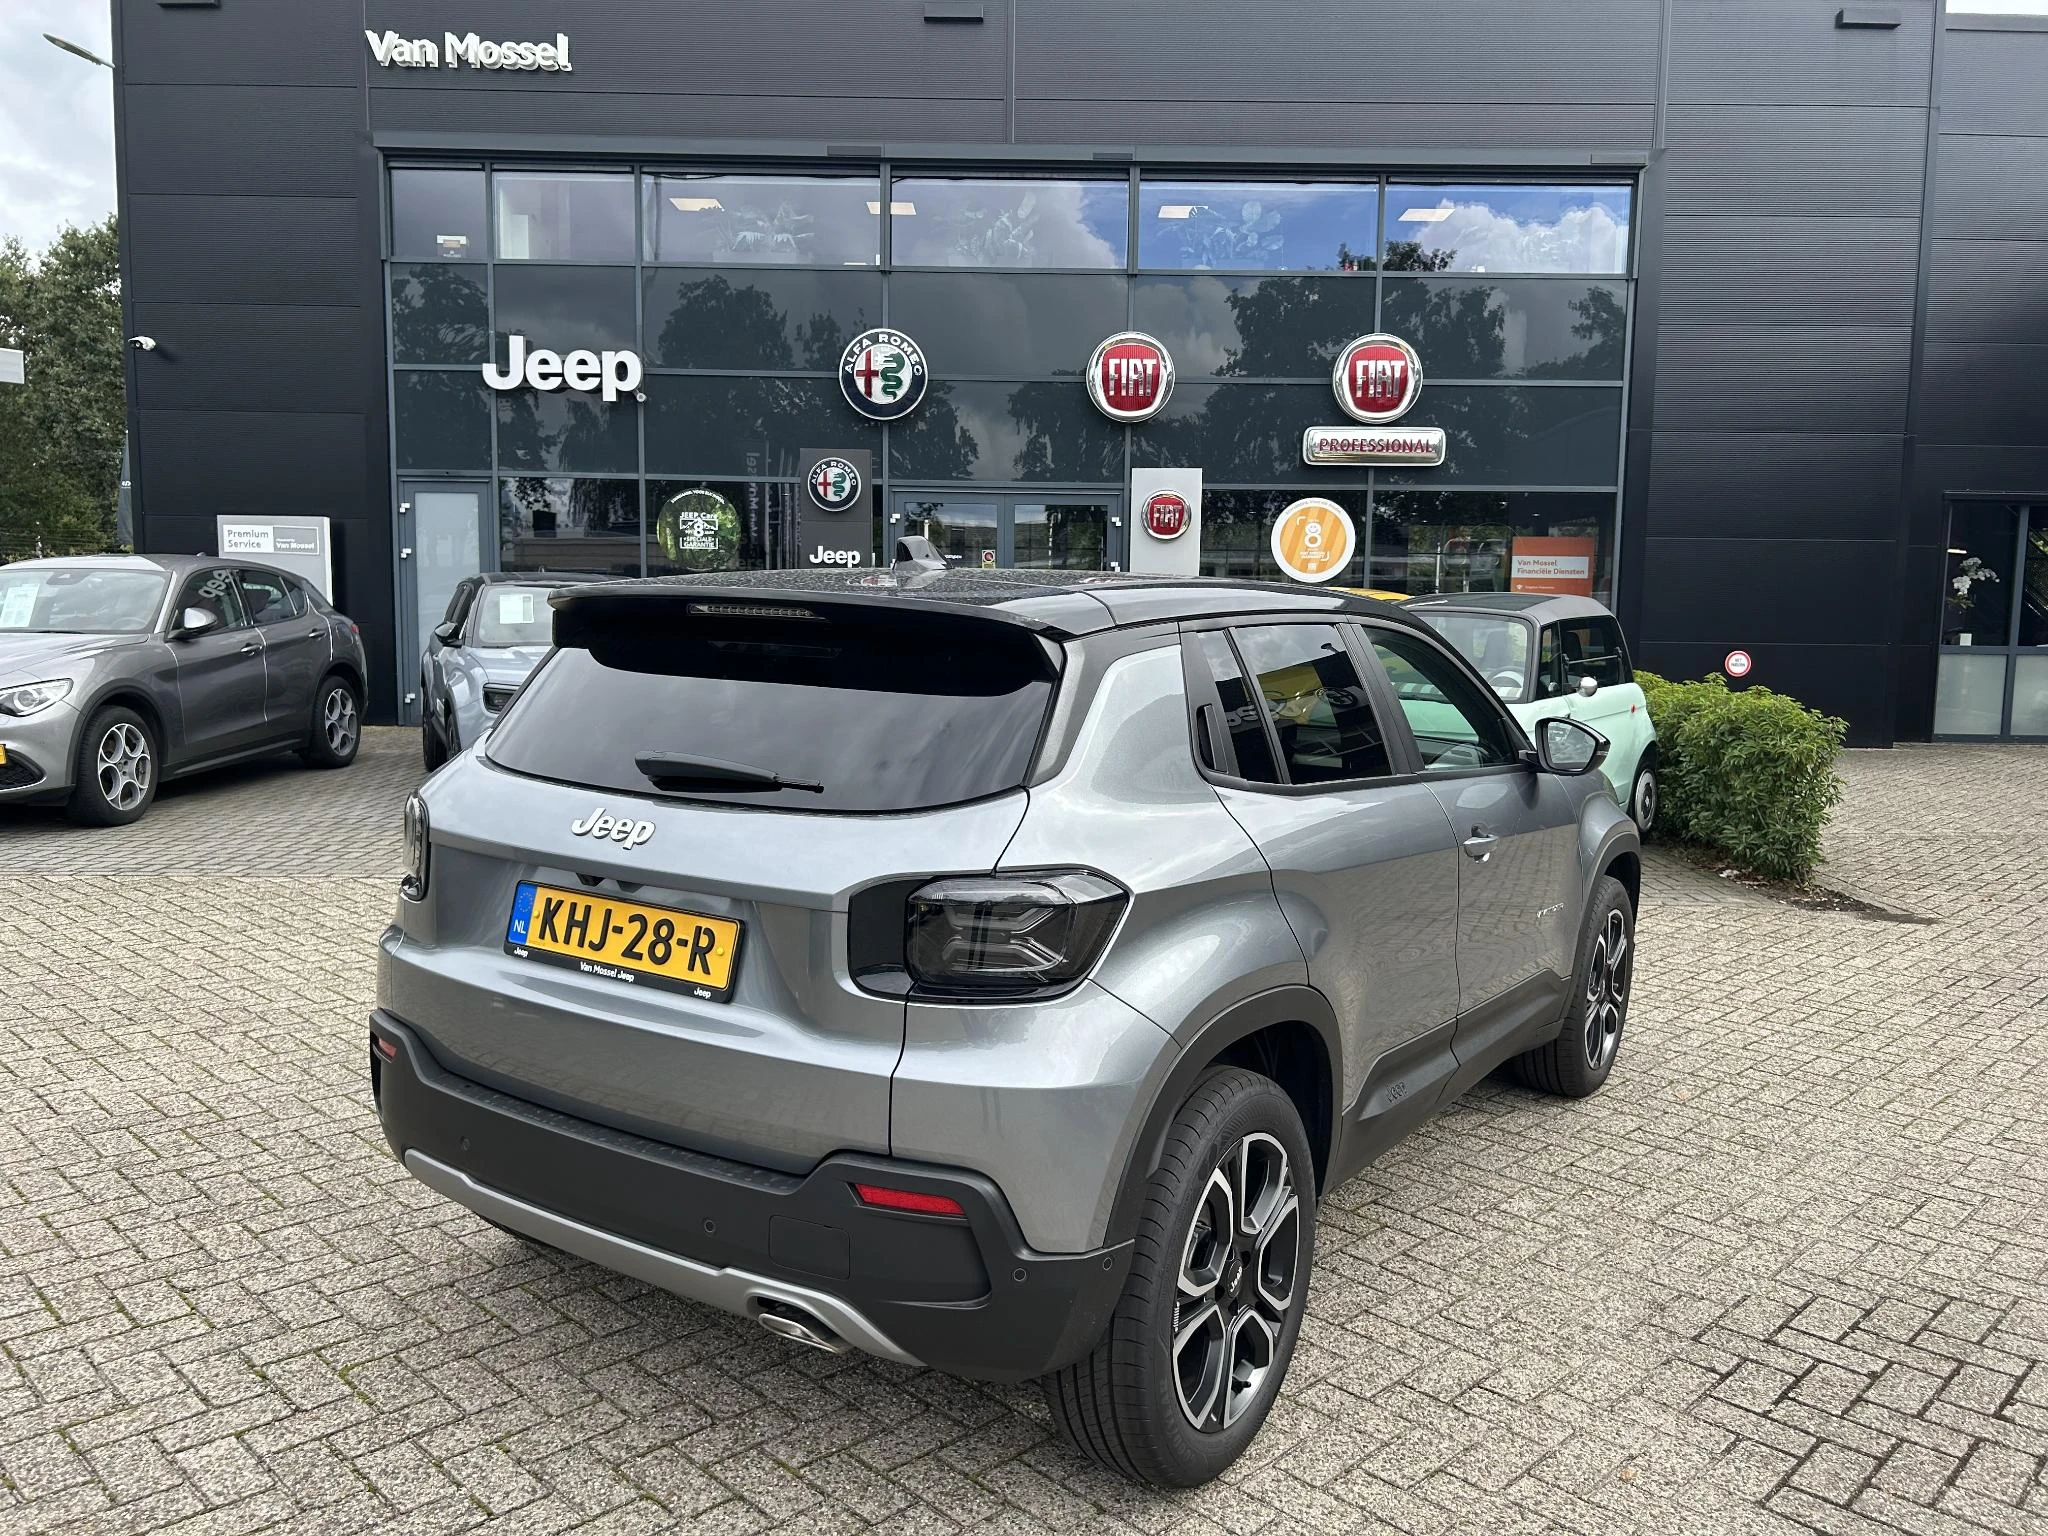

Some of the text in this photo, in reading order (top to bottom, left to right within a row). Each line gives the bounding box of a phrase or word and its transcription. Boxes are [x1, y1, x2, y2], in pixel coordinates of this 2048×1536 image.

[365, 30, 572, 71] Van Mossel
[844, 333, 923, 376] ALFA ROMEO
[482, 335, 642, 402] Jeep
[1108, 358, 1157, 397] FIAT
[1355, 360, 1406, 398] FIAT
[1319, 438, 1434, 453] PROFESSIONAL
[811, 461, 857, 486] ALFA ROMEO
[680, 511, 698, 519] JEEP
[1153, 504, 1183, 528] FIAT
[227, 529, 269, 538] Premium
[228, 539, 262, 548] Service
[290, 542, 315, 550] Mossel
[809, 545, 860, 568] Jeep
[1517, 567, 1585, 576] Financiële Diensten
[571, 807, 656, 850] Jeep
[513, 919, 526, 934] NL
[538, 897, 716, 976] KHJ-28-R
[513, 946, 528, 958] Jeep
[580, 961, 634, 983] Van Mossel Jeep
[693, 987, 712, 999] Jeep
